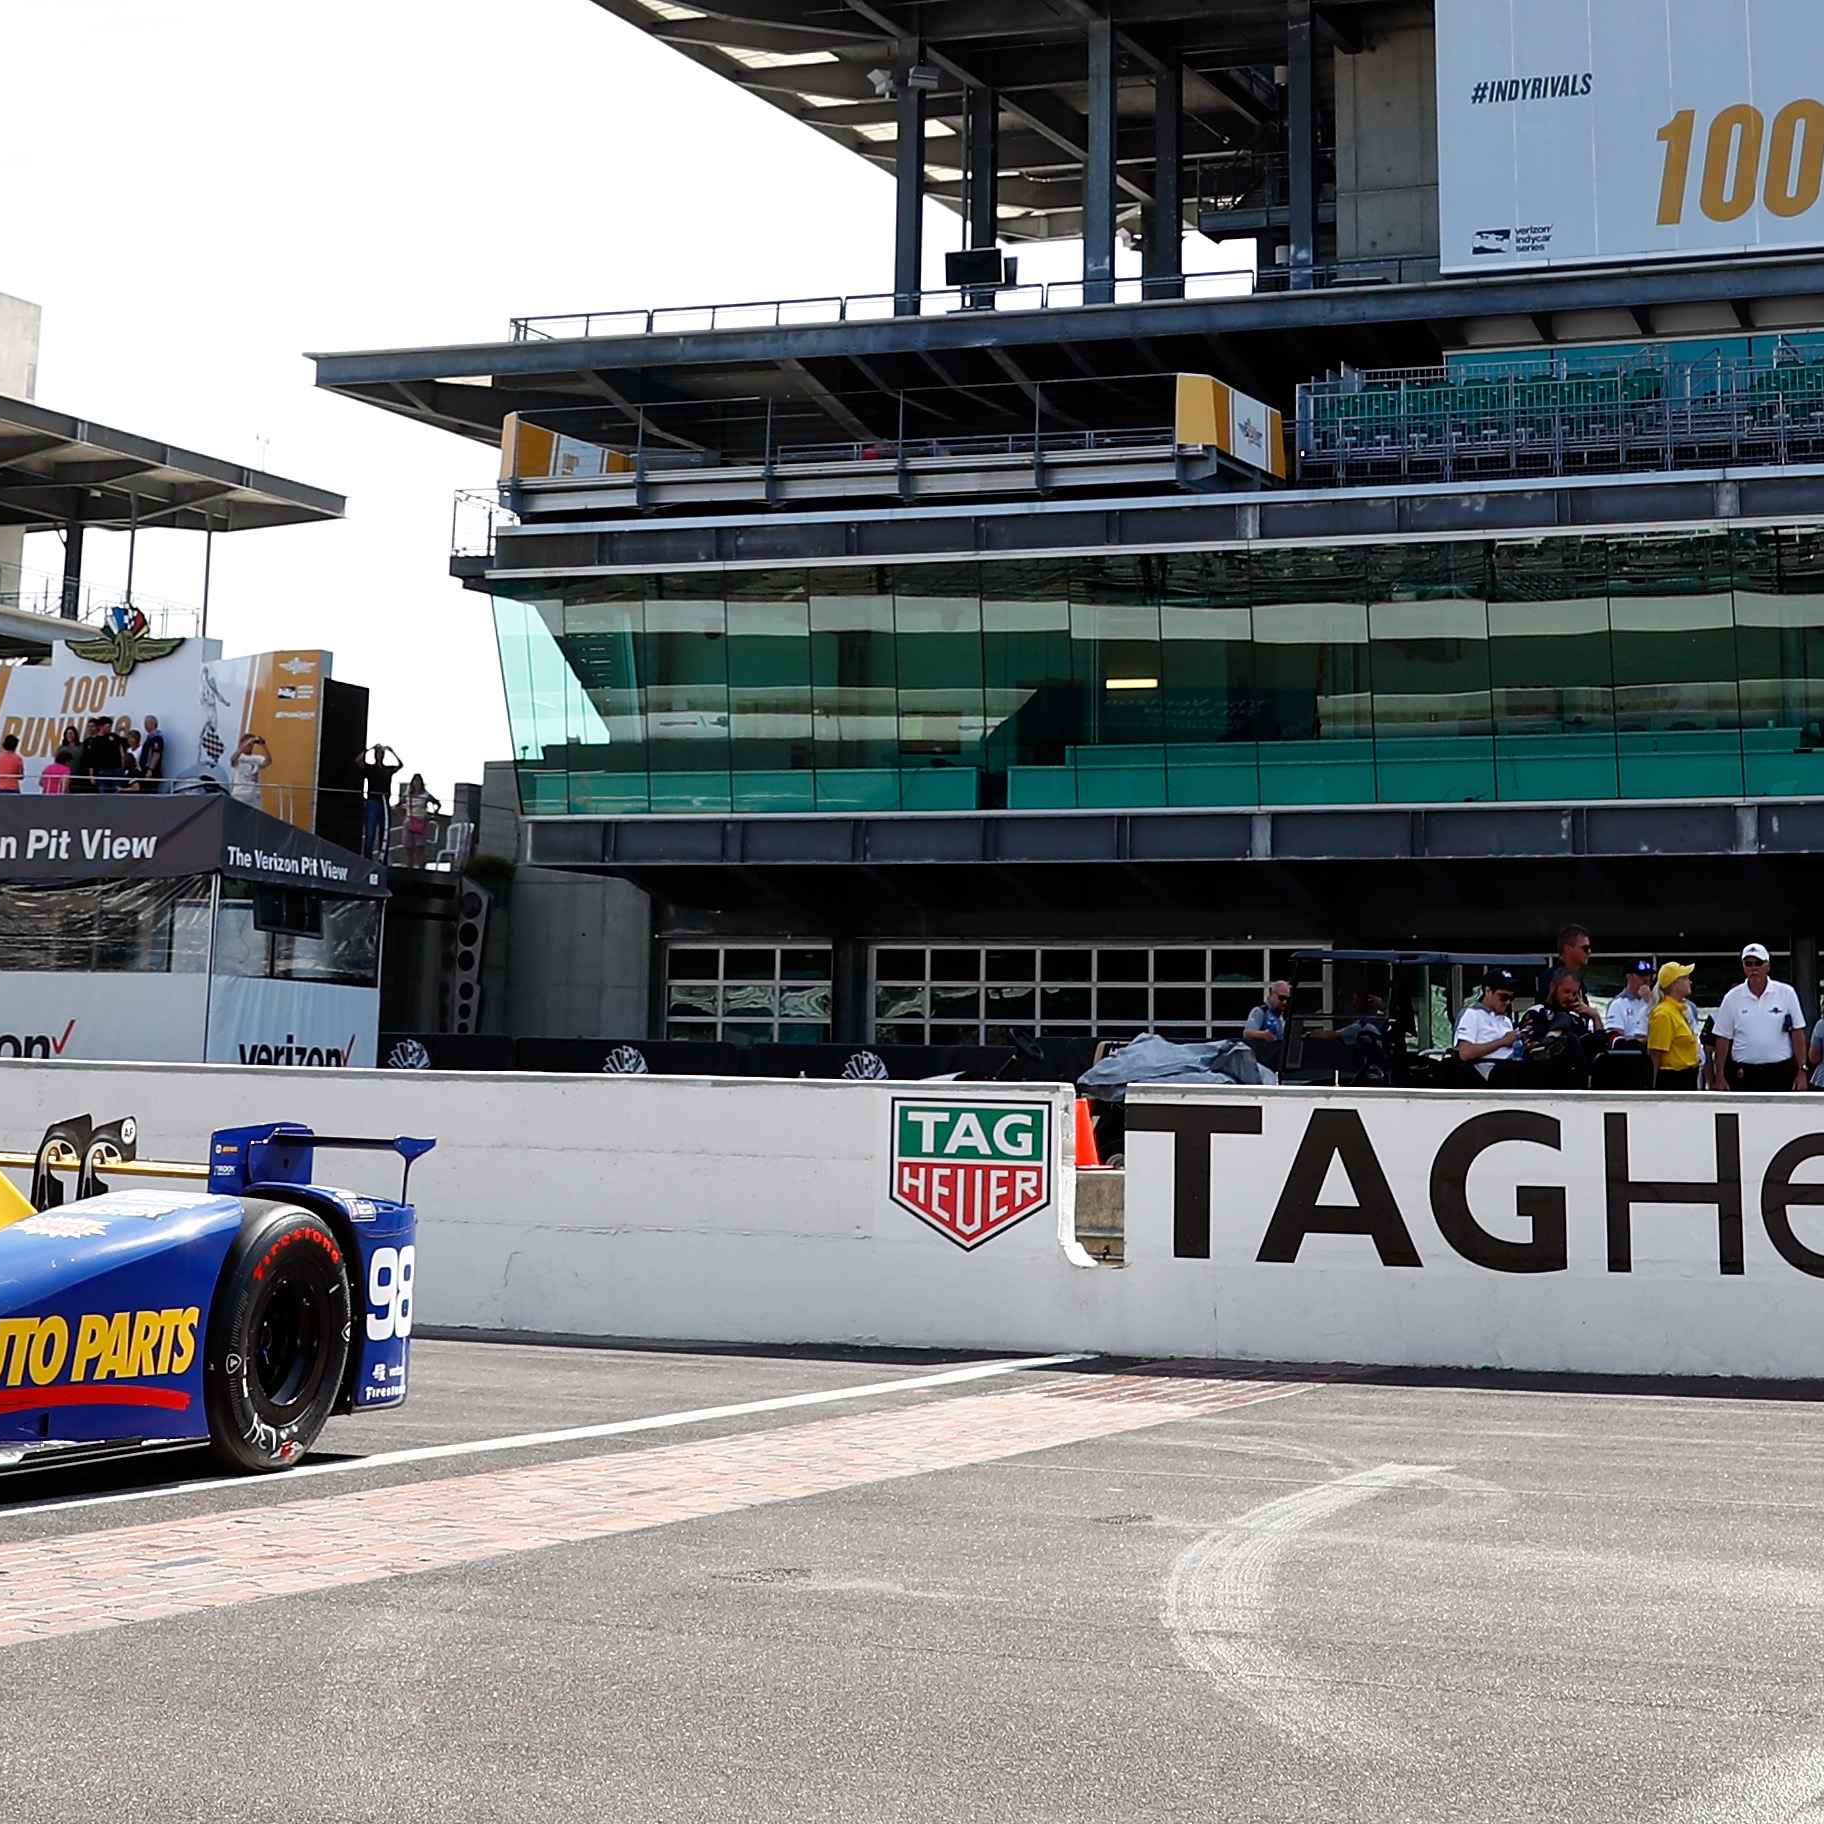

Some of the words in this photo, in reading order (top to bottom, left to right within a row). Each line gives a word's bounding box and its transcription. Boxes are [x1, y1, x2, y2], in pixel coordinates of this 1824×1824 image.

[1471, 73, 1594, 105] #INDYRIVALS
[61, 675, 128, 714] 100TH
[26, 829, 71, 860] Pit
[80, 829, 158, 860] View
[228, 846, 252, 868] The
[254, 849, 300, 874] Verizon
[301, 857, 318, 877] Pit
[320, 859, 349, 881] View
[239, 1034, 342, 1067] verizon
[907, 1110, 1033, 1157] TAG
[903, 1167, 1038, 1236] HEUER
[253, 1226, 341, 1280] Firestone
[366, 1245, 416, 1341] 98
[69, 1307, 200, 1383] PARTS
